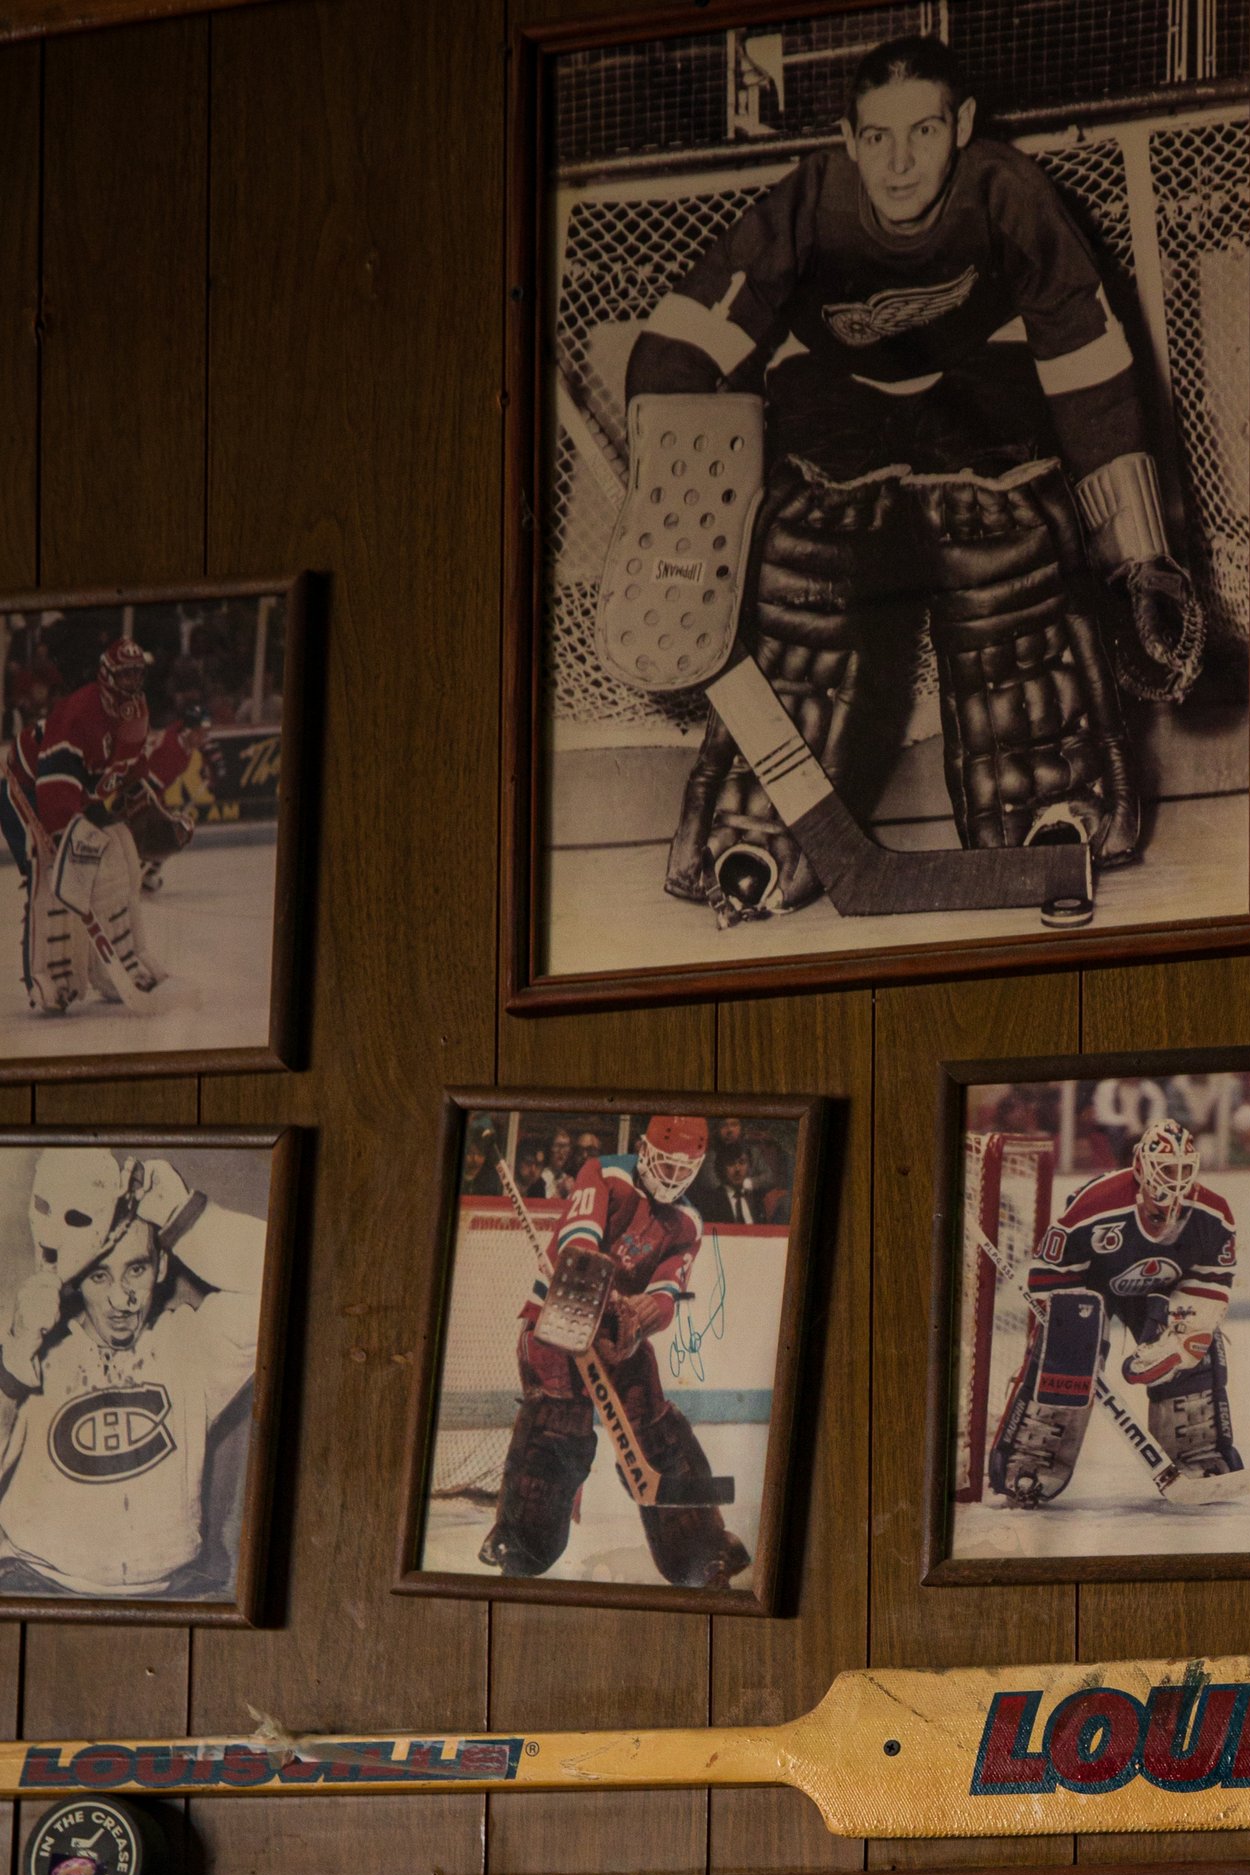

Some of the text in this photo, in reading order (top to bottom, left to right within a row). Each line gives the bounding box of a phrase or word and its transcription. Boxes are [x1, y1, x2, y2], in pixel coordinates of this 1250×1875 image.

[655, 560, 703, 582] LIPPMANS
[503, 1180, 544, 1259] MONTREAL
[566, 1186, 597, 1220] 20
[1040, 1377, 1090, 1391] VAUGHN
[587, 1362, 648, 1497] MONTREAL
[1002, 1399, 1026, 1444] VAUGHN
[1218, 1402, 1232, 1438] LEGACY
[39, 1810, 130, 1873] IN THE CREASE
